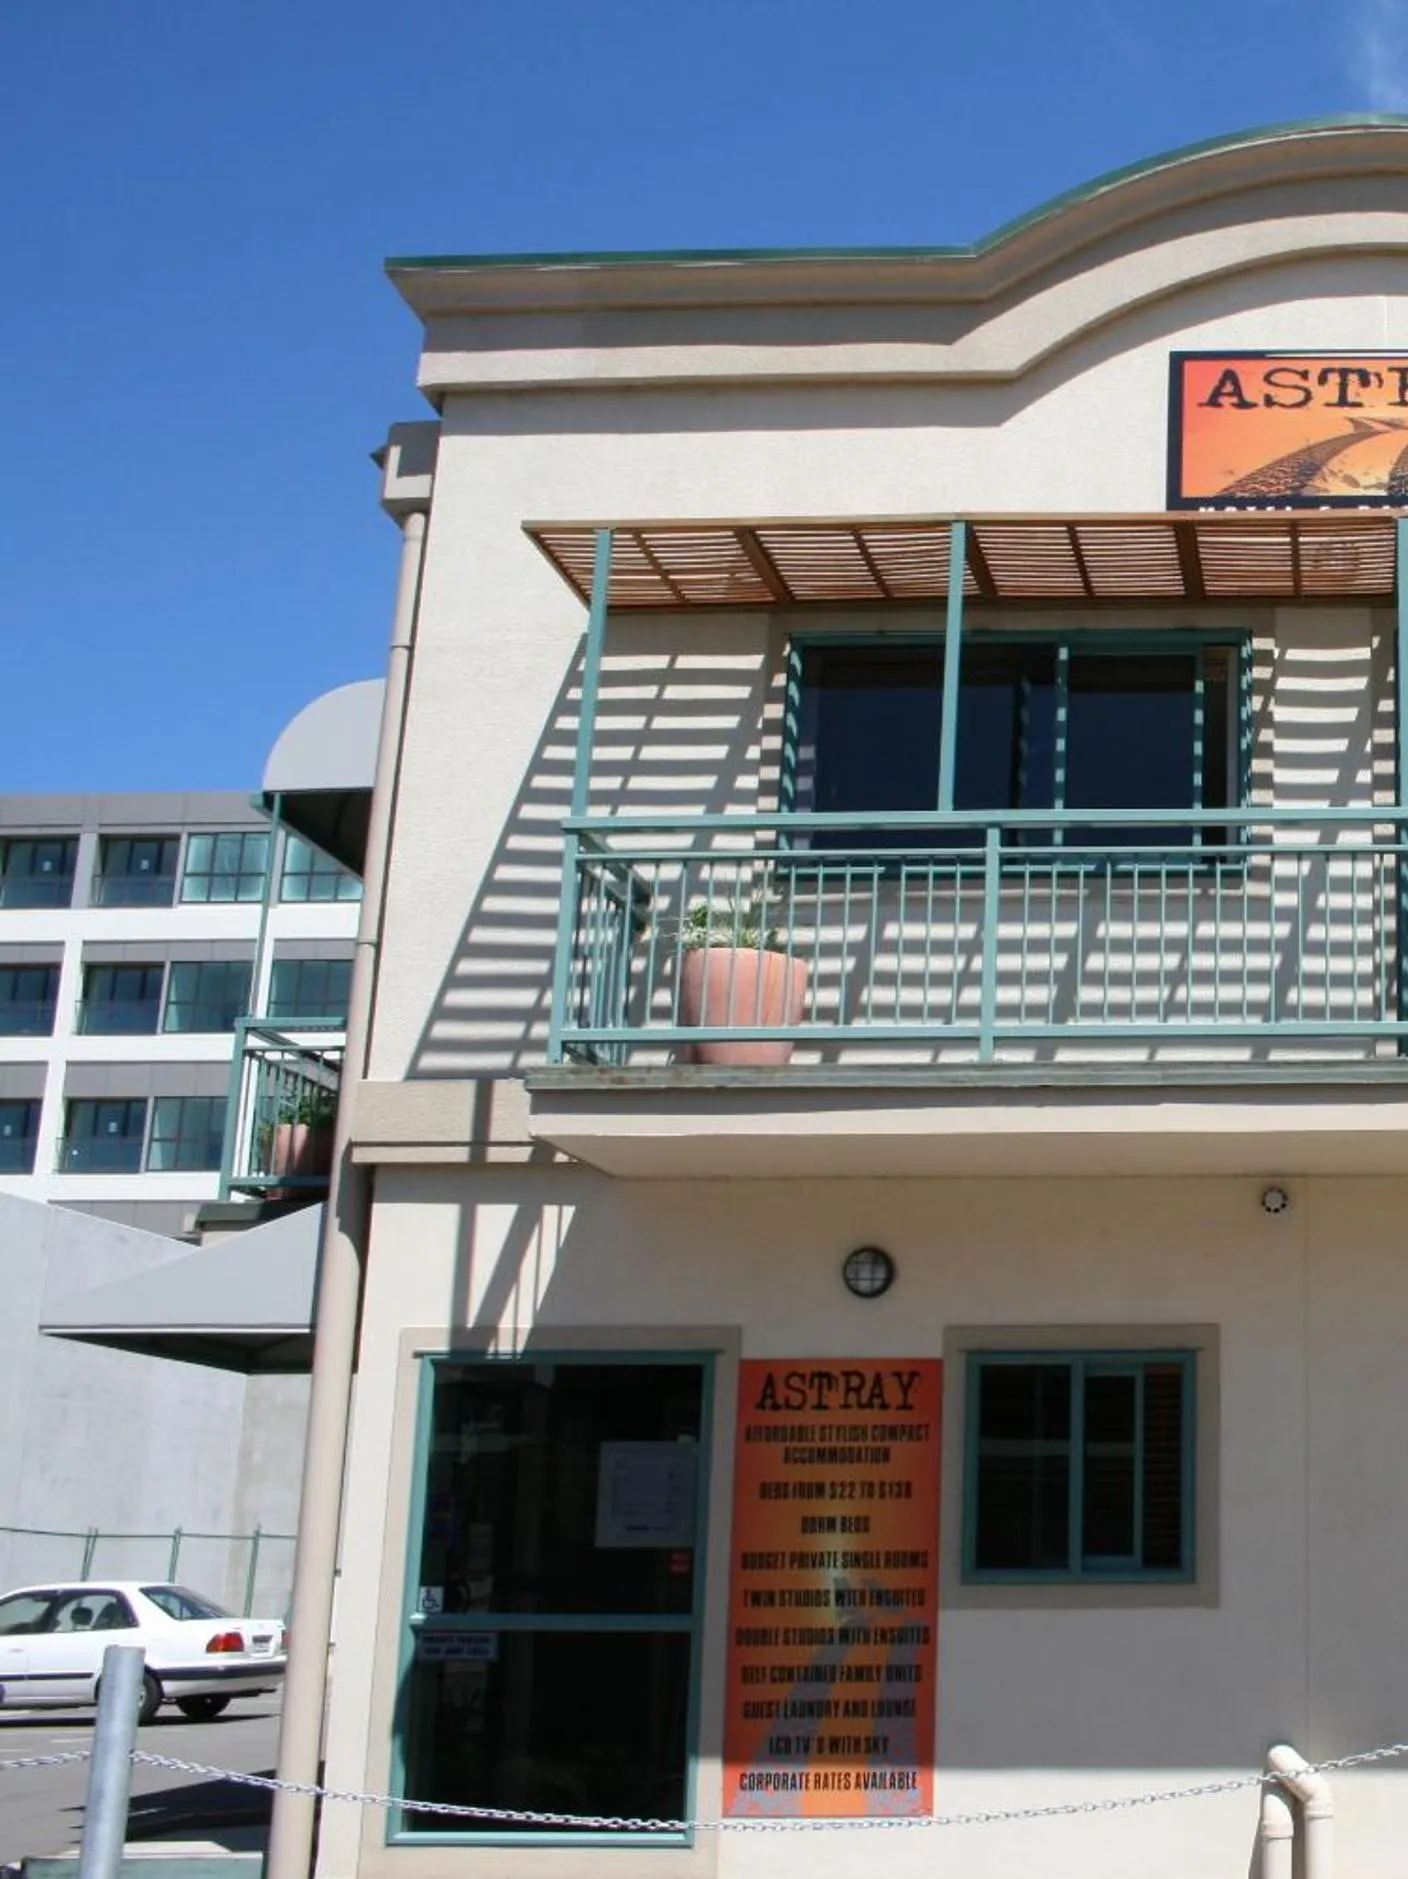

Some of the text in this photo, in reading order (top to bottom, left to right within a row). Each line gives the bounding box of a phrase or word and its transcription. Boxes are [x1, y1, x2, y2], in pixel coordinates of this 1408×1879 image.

[755, 1370, 921, 1411] ASTRAY
[745, 1424, 816, 1443] AFFORDABLE
[871, 1424, 930, 1443] COMPACT
[784, 1447, 890, 1464] ACCOMMODATION
[829, 1482, 855, 1500] $22
[789, 1552, 839, 1570] PRIVATE
[841, 1552, 881, 1570] SINGLE
[744, 1589, 776, 1607] TWIN
[778, 1589, 830, 1607] STUDIOS
[770, 1665, 836, 1683] CONTAINED
[840, 1665, 881, 1683] FAMILY
[784, 1700, 840, 1719] LAUNDRY
[843, 1700, 868, 1719] AND
[829, 1736, 860, 1756] WITH
[864, 1736, 890, 1756] SKY
[739, 1772, 917, 1791] CORPORATE RATES AVAILABLE
